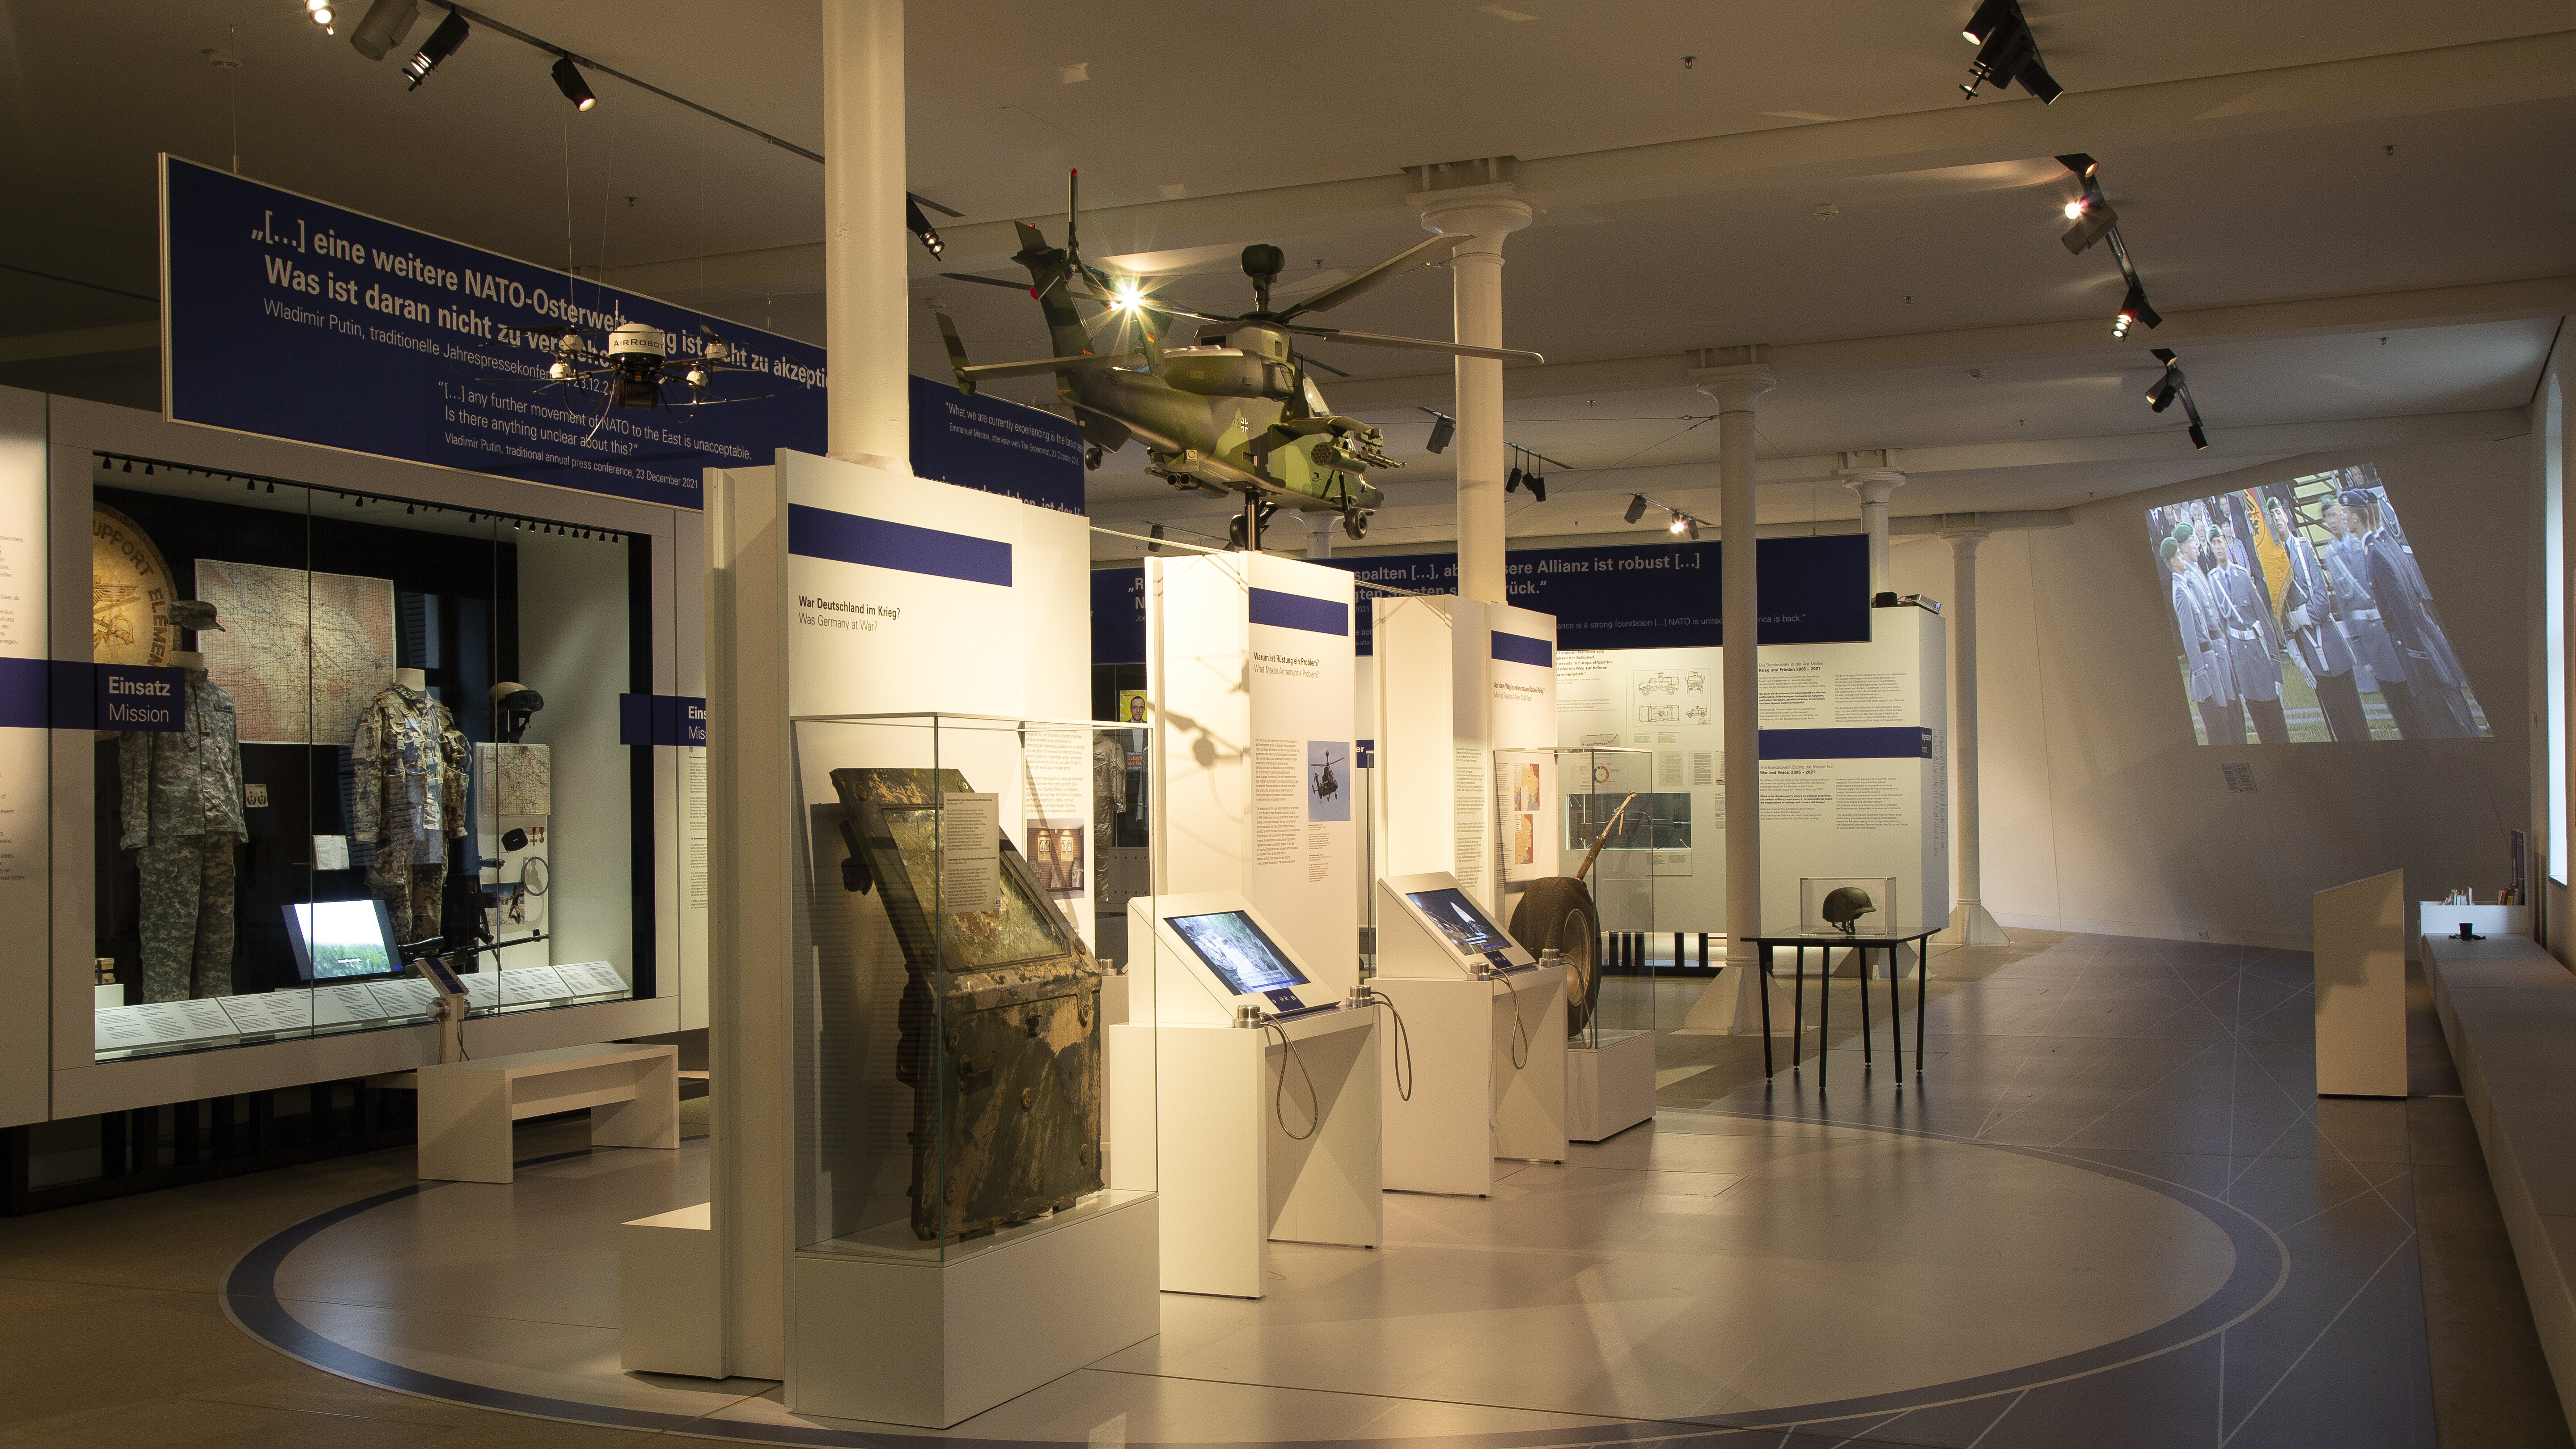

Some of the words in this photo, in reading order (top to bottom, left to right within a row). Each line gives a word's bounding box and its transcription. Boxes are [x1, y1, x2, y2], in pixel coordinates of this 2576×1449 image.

[265, 254, 320, 295] Was
[328, 271, 358, 305] ist
[366, 284, 430, 323] daran
[438, 305, 491, 339] nicht
[498, 323, 521, 346] zu
[314, 229, 365, 264] eine
[372, 249, 458, 291] weitere
[682, 329, 702, 356] ist
[751, 353, 768, 373] zu
[264, 298, 325, 327] Wladimir
[330, 314, 364, 339] Putin,
[370, 326, 439, 355] traditionelle
[446, 406, 455, 421] Is
[458, 409, 488, 428] there
[492, 419, 537, 440] anything
[541, 428, 576, 445] unclear
[580, 435, 607, 451] about
[468, 391, 487, 408] any
[491, 392, 527, 412] further
[531, 404, 585, 426] movement
[589, 415, 598, 428] of
[602, 415, 629, 435] NATO
[632, 424, 641, 437] to
[644, 426, 659, 441] the
[662, 429, 682, 446] East
[684, 434, 691, 447] is
[694, 438, 751, 459] unacceptable.
[967, 411, 976, 420] we
[978, 413, 987, 423] are
[989, 416, 1013, 432] currently
[1015, 424, 1049, 442] experiencing
[1051, 431, 1055, 441] is
[1056, 433, 1065, 445] the
[1066, 436, 1076, 449] brain
[949, 423, 972, 435] Emmanuel
[974, 428, 991, 441] Macron,
[991, 433, 1010, 446] interview
[1011, 439, 1020, 448] with
[1030, 443, 1051, 457] Economist,
[1051, 449, 1056, 458] 21
[1057, 450, 1071, 462] October
[445, 432, 479, 448] Vladimir
[481, 439, 503, 454] Putin,
[506, 445, 543, 461] traditional
[546, 453, 569, 466] annual
[572, 458, 591, 470] press
[593, 463, 634, 479] conference,
[636, 469, 644, 479] 23
[647, 470, 680, 486] December
[682, 478, 698, 489] 2021
[93, 520, 154, 576] UPPORT
[1355, 567, 1406, 581] spalten
[1538, 560, 1589, 573] Allianz
[1594, 558, 1613, 571] ist
[1618, 555, 1669, 570] robust
[799, 595, 814, 608] War
[817, 597, 864, 614] Deutschland
[866, 604, 875, 615] im
[878, 606, 900, 620] Krieg?
[1355, 589, 1383, 604] gten
[799, 612, 815, 625] Was
[818, 614, 849, 631] Germany
[852, 620, 858, 630] at
[860, 619, 877, 632] War?
[1590, 621, 1612, 630] strong
[1615, 619, 1652, 627] foundation
[1254, 652, 1269, 661] Warum
[1276, 655, 1293, 666] Rüstung
[1301, 658, 1319, 667] Problem?
[1254, 664, 1265, 673] What
[1266, 665, 1278, 674] Makes
[1279, 667, 1299, 677] Armament
[1302, 669, 1319, 678] Problem?
[109, 676, 170, 696] Einsatz
[109, 703, 169, 722] Mission
[689, 706, 706, 720] Eins
